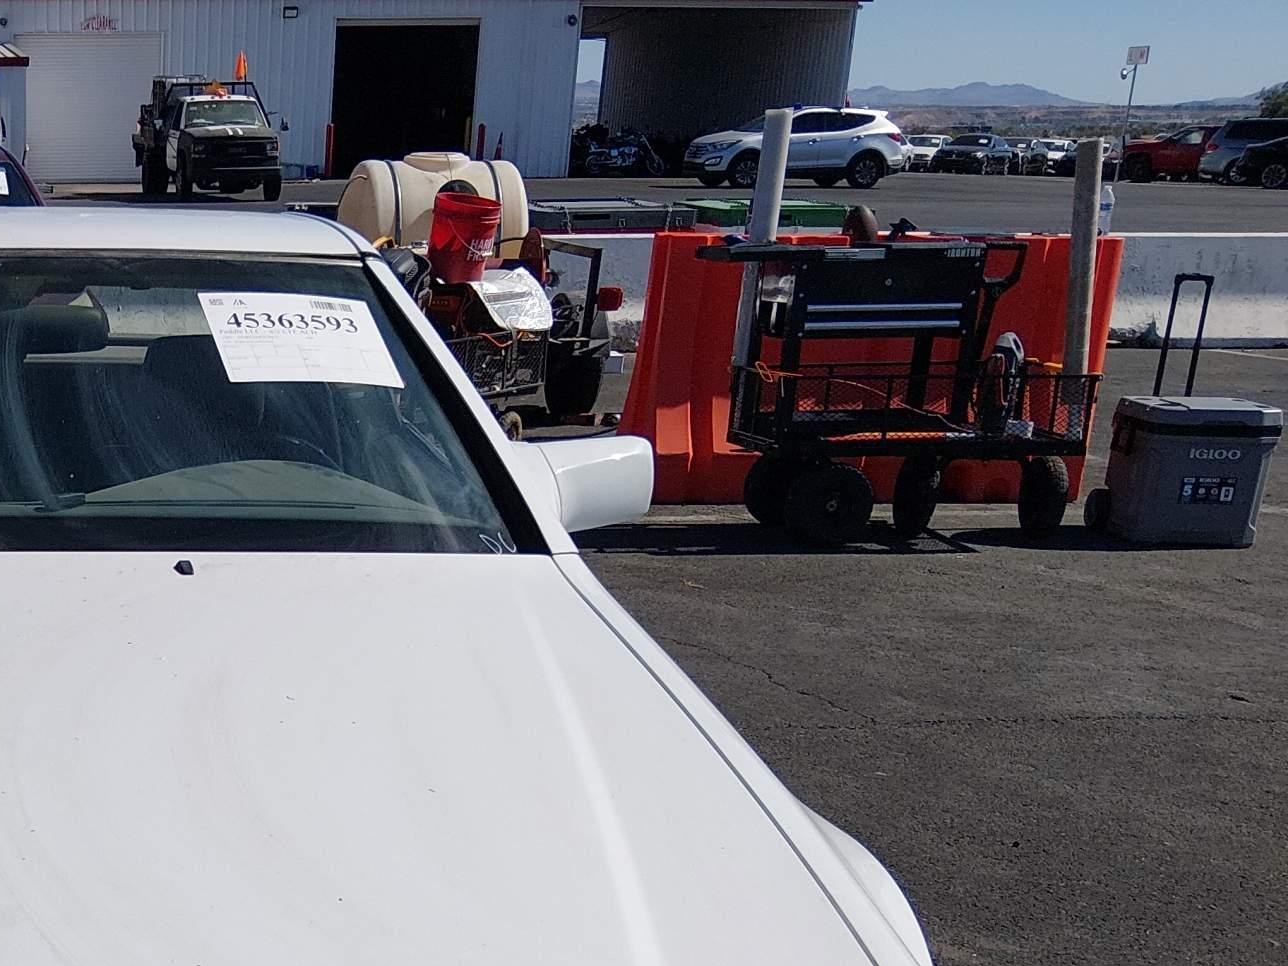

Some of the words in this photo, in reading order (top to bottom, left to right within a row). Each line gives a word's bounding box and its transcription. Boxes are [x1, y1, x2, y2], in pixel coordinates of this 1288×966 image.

[947, 248, 981, 257] IRONTON
[226, 312, 359, 334] 45363593
[1189, 449, 1241, 460] IGLOO
